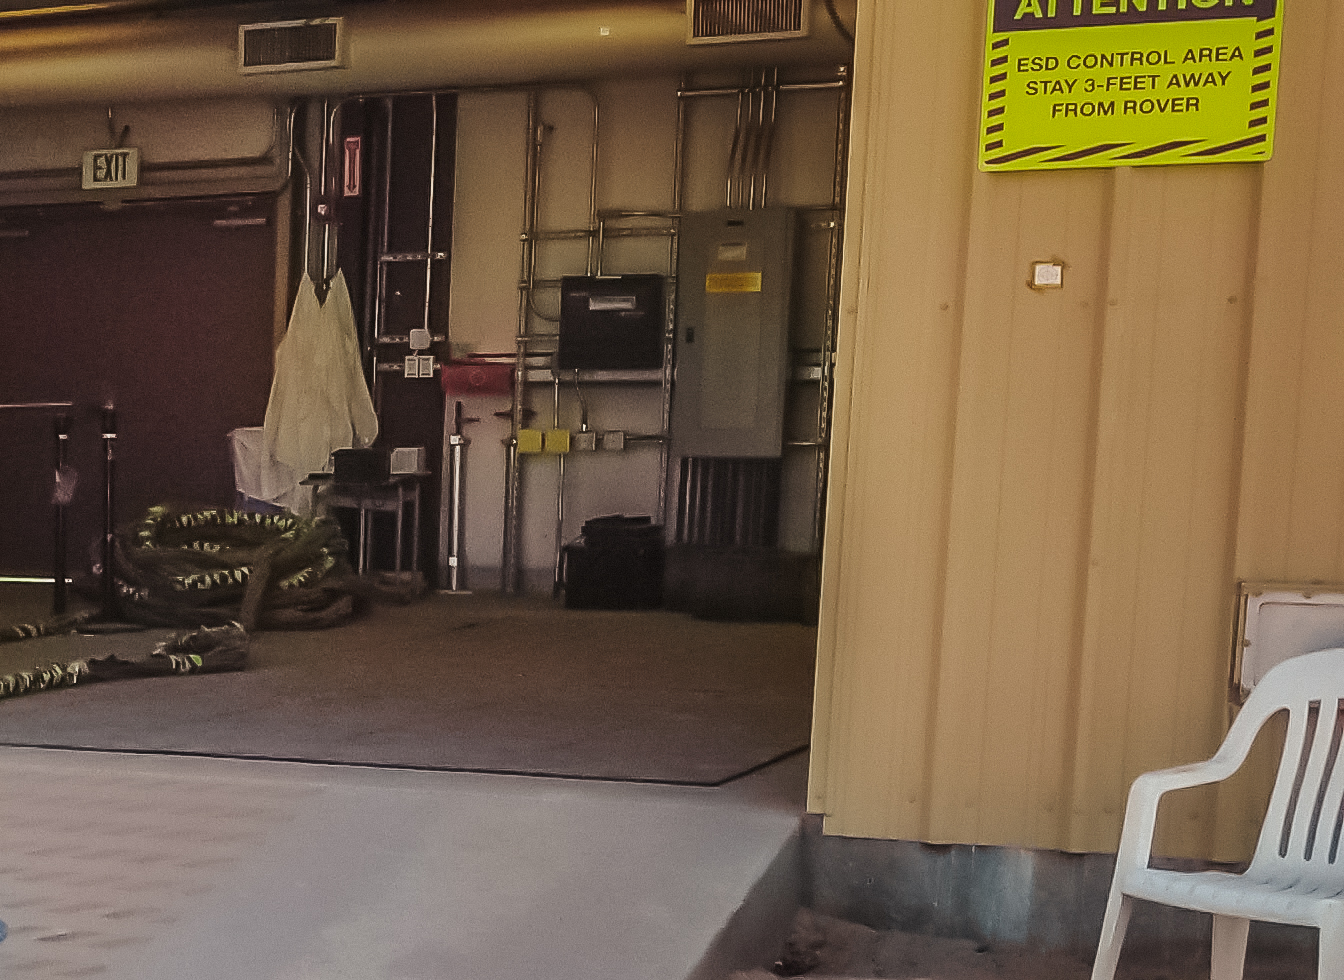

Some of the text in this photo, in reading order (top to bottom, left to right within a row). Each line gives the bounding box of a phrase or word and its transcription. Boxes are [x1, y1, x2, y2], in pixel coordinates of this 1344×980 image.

[1014, 0, 1255, 20] ATTEN
[1016, 46, 1244, 73] ESD CONTROL AREA
[1025, 71, 1232, 96] STAY 3-FEET AWAY
[1051, 97, 1200, 118] FROM ROVER
[93, 152, 130, 182] EXIT
